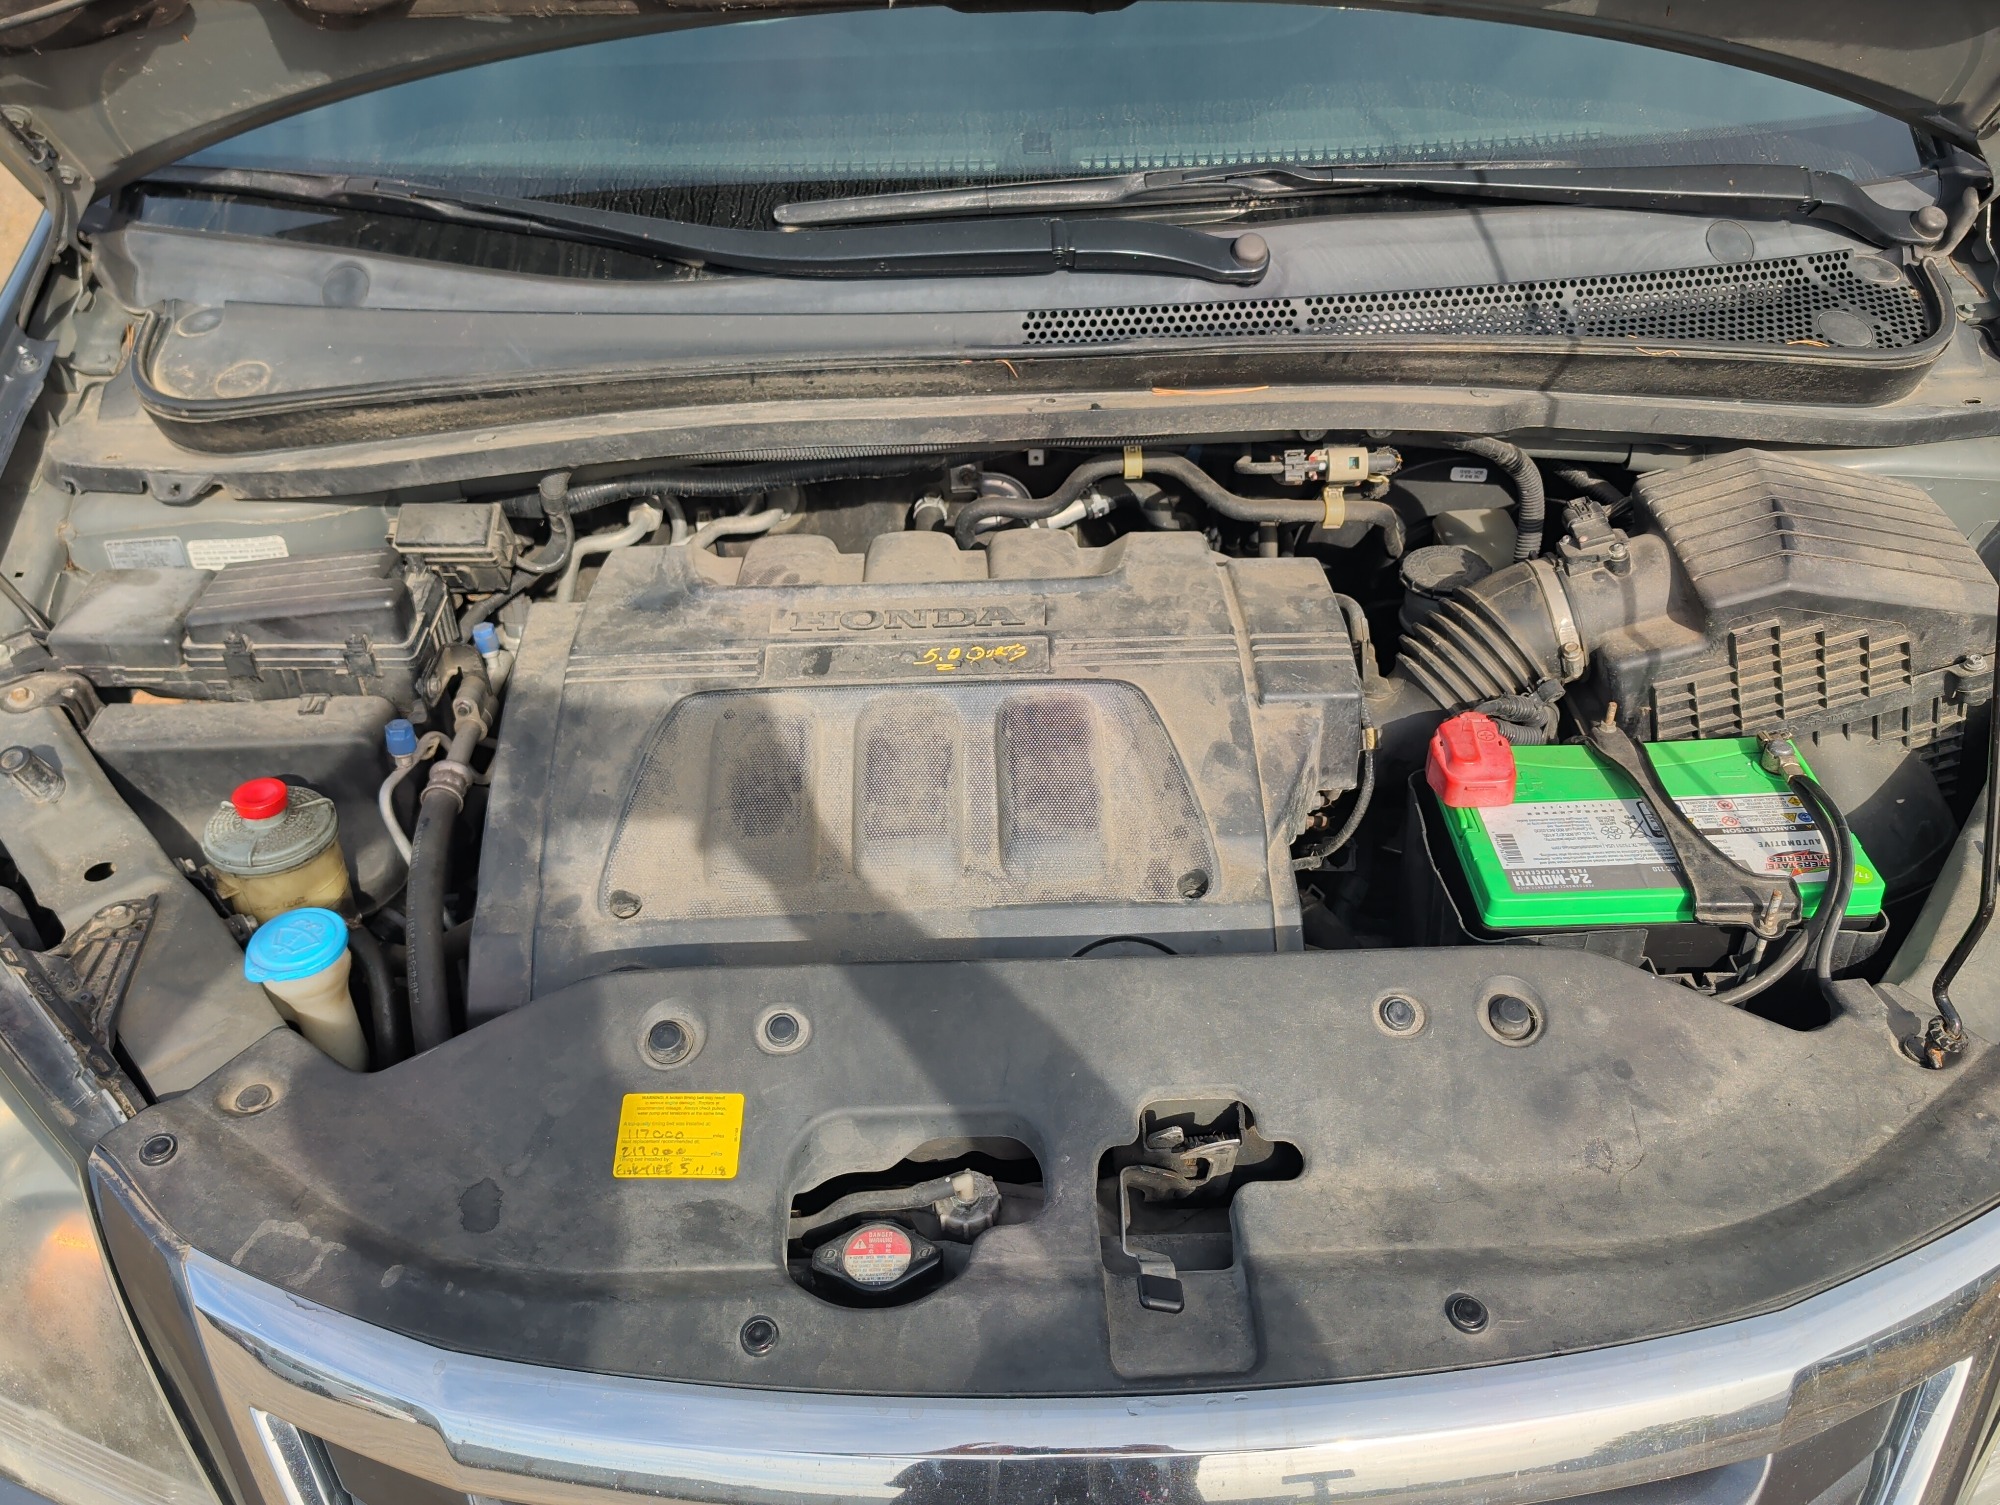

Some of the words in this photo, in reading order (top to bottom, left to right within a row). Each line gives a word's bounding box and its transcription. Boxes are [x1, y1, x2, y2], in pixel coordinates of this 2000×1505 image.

[790, 606, 1025, 631] HONDA
[1722, 825, 1796, 834] DANGER/POISON
[1757, 838, 1820, 848] AUTOMOTIVE
[1512, 873, 1592, 886] 24-MONTH
